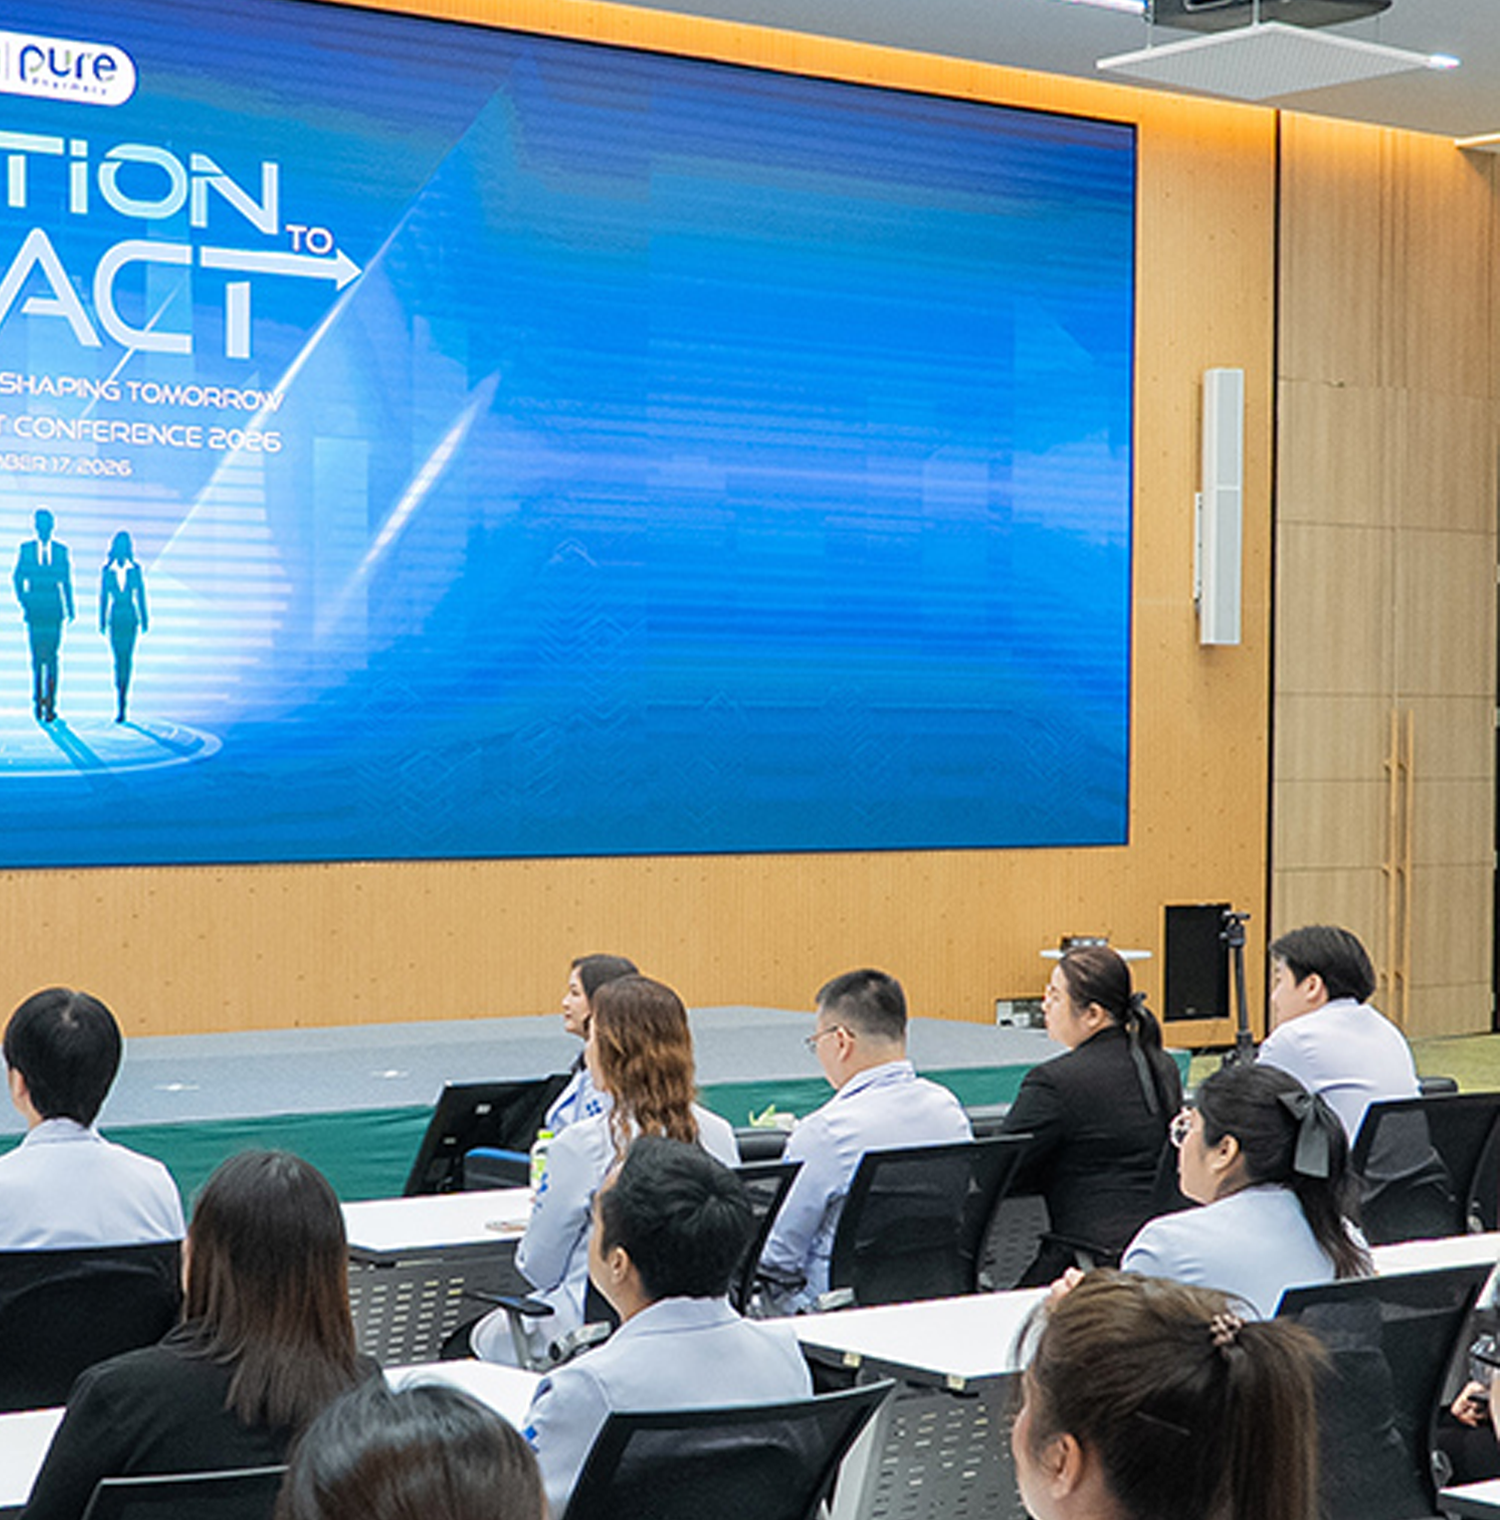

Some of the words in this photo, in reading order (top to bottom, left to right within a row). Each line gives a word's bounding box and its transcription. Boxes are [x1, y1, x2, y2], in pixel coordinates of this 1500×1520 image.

[19, 43, 118, 83] pure
[285, 223, 335, 255] TO
[125, 380, 285, 412] TOMORROW
[13, 414, 203, 449] CONFERENCE
[207, 427, 283, 453] 2026
[77, 457, 133, 477] 2026
